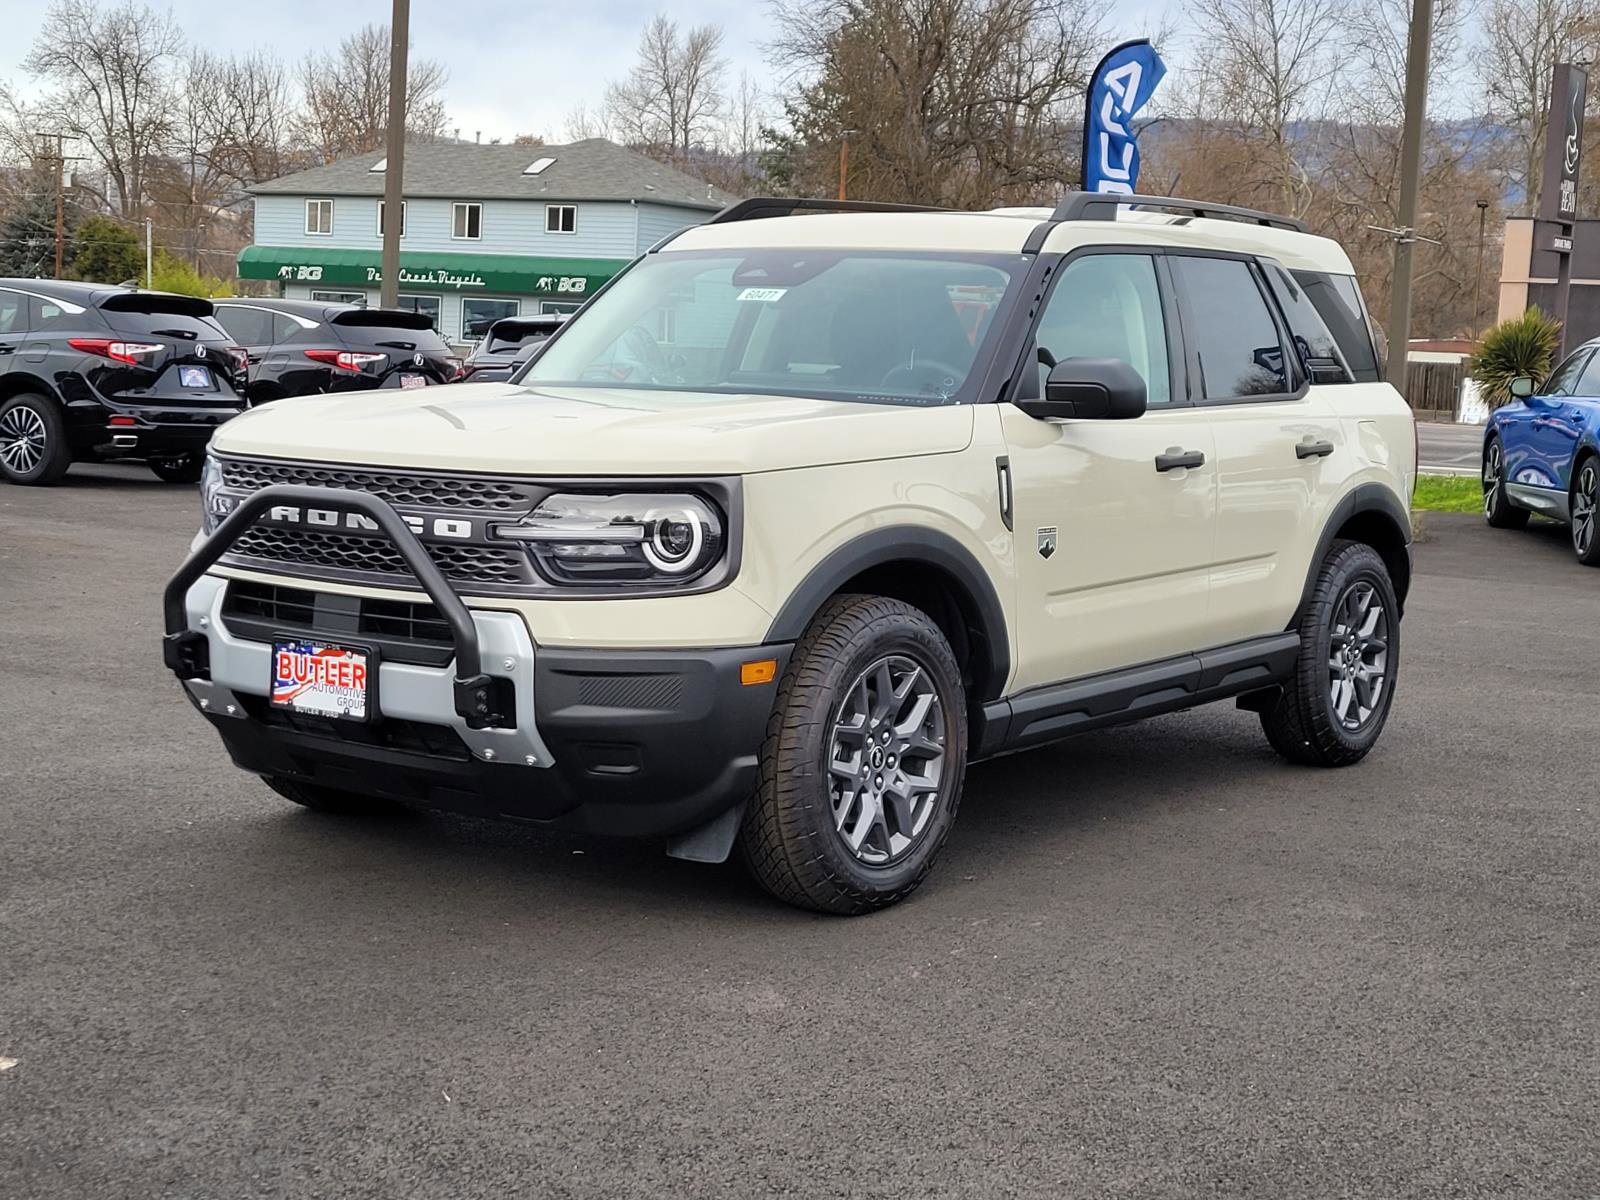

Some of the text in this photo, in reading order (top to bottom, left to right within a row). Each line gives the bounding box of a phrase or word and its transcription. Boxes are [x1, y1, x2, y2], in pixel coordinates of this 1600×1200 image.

[366, 267, 485, 288] Be Creek Bicycle
[279, 653, 367, 690] BUTLER
[312, 683, 366, 699] AUTOMOTIVE
[337, 697, 366, 710] GROUP
